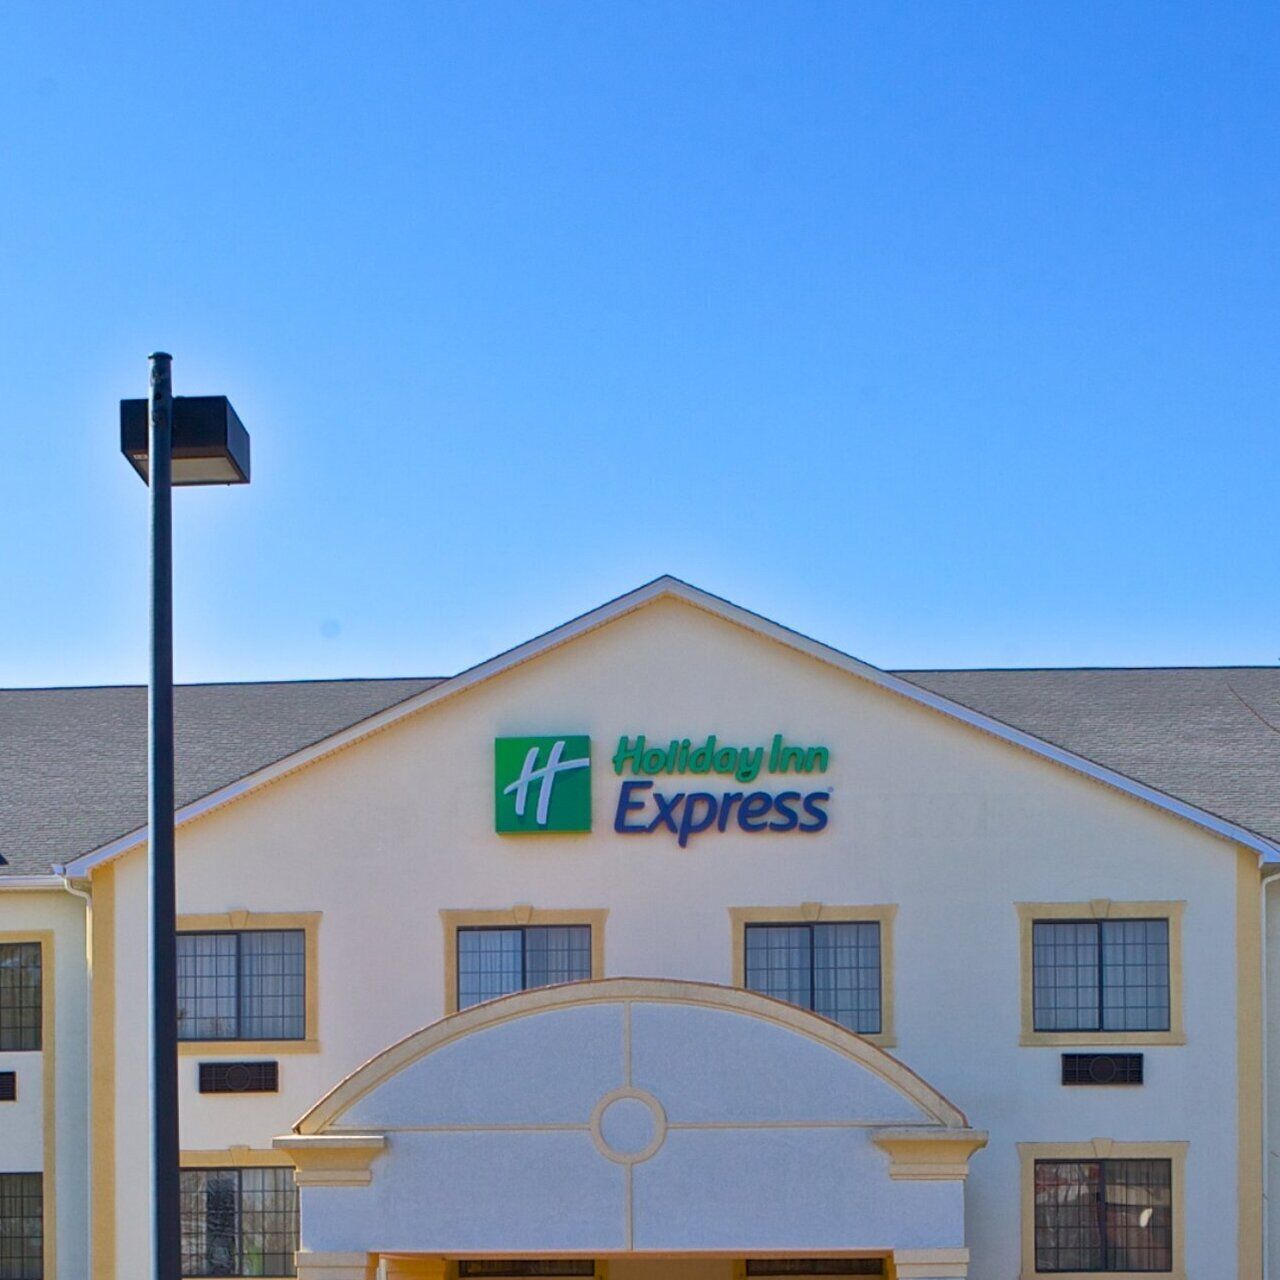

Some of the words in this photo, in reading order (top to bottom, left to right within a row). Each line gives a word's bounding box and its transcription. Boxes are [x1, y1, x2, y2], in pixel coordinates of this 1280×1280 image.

[612, 735, 763, 782] Holiday
[768, 734, 829, 774] Inn
[614, 780, 830, 848] Express
